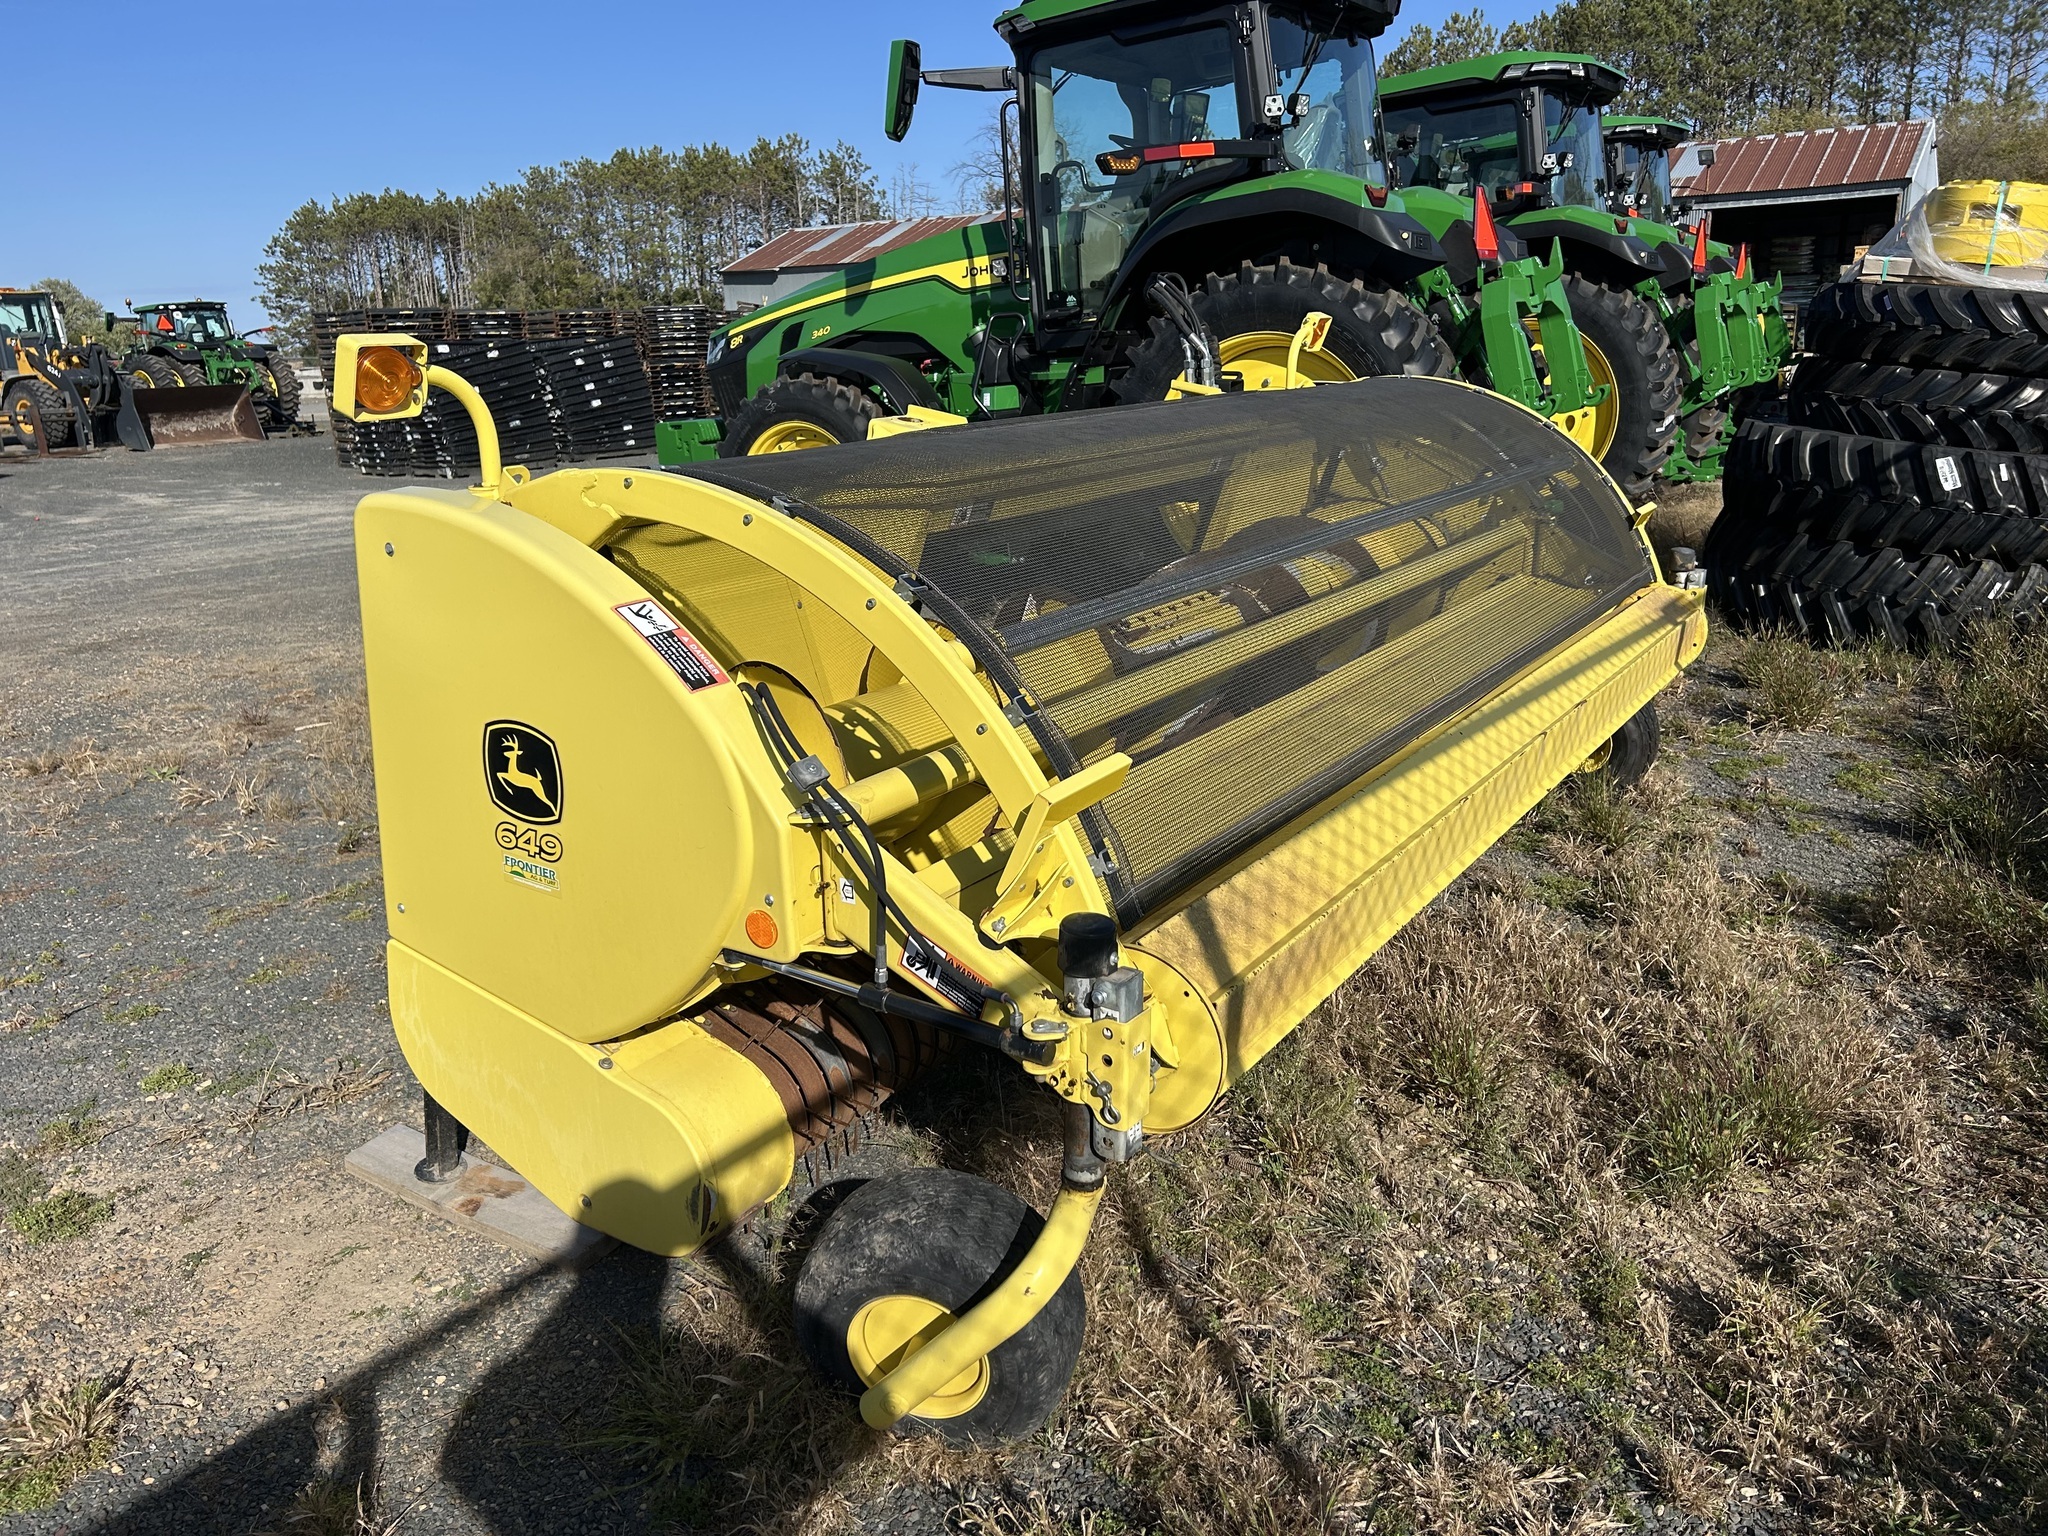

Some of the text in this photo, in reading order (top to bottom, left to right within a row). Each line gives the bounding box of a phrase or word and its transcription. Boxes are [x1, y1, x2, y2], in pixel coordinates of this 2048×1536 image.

[729, 334, 744, 349] 8R
[811, 325, 831, 340] 340
[47, 364, 61, 378] 624J
[690, 644, 719, 675] DANGER
[495, 822, 563, 863] 649
[505, 856, 556, 880] FRONTIER
